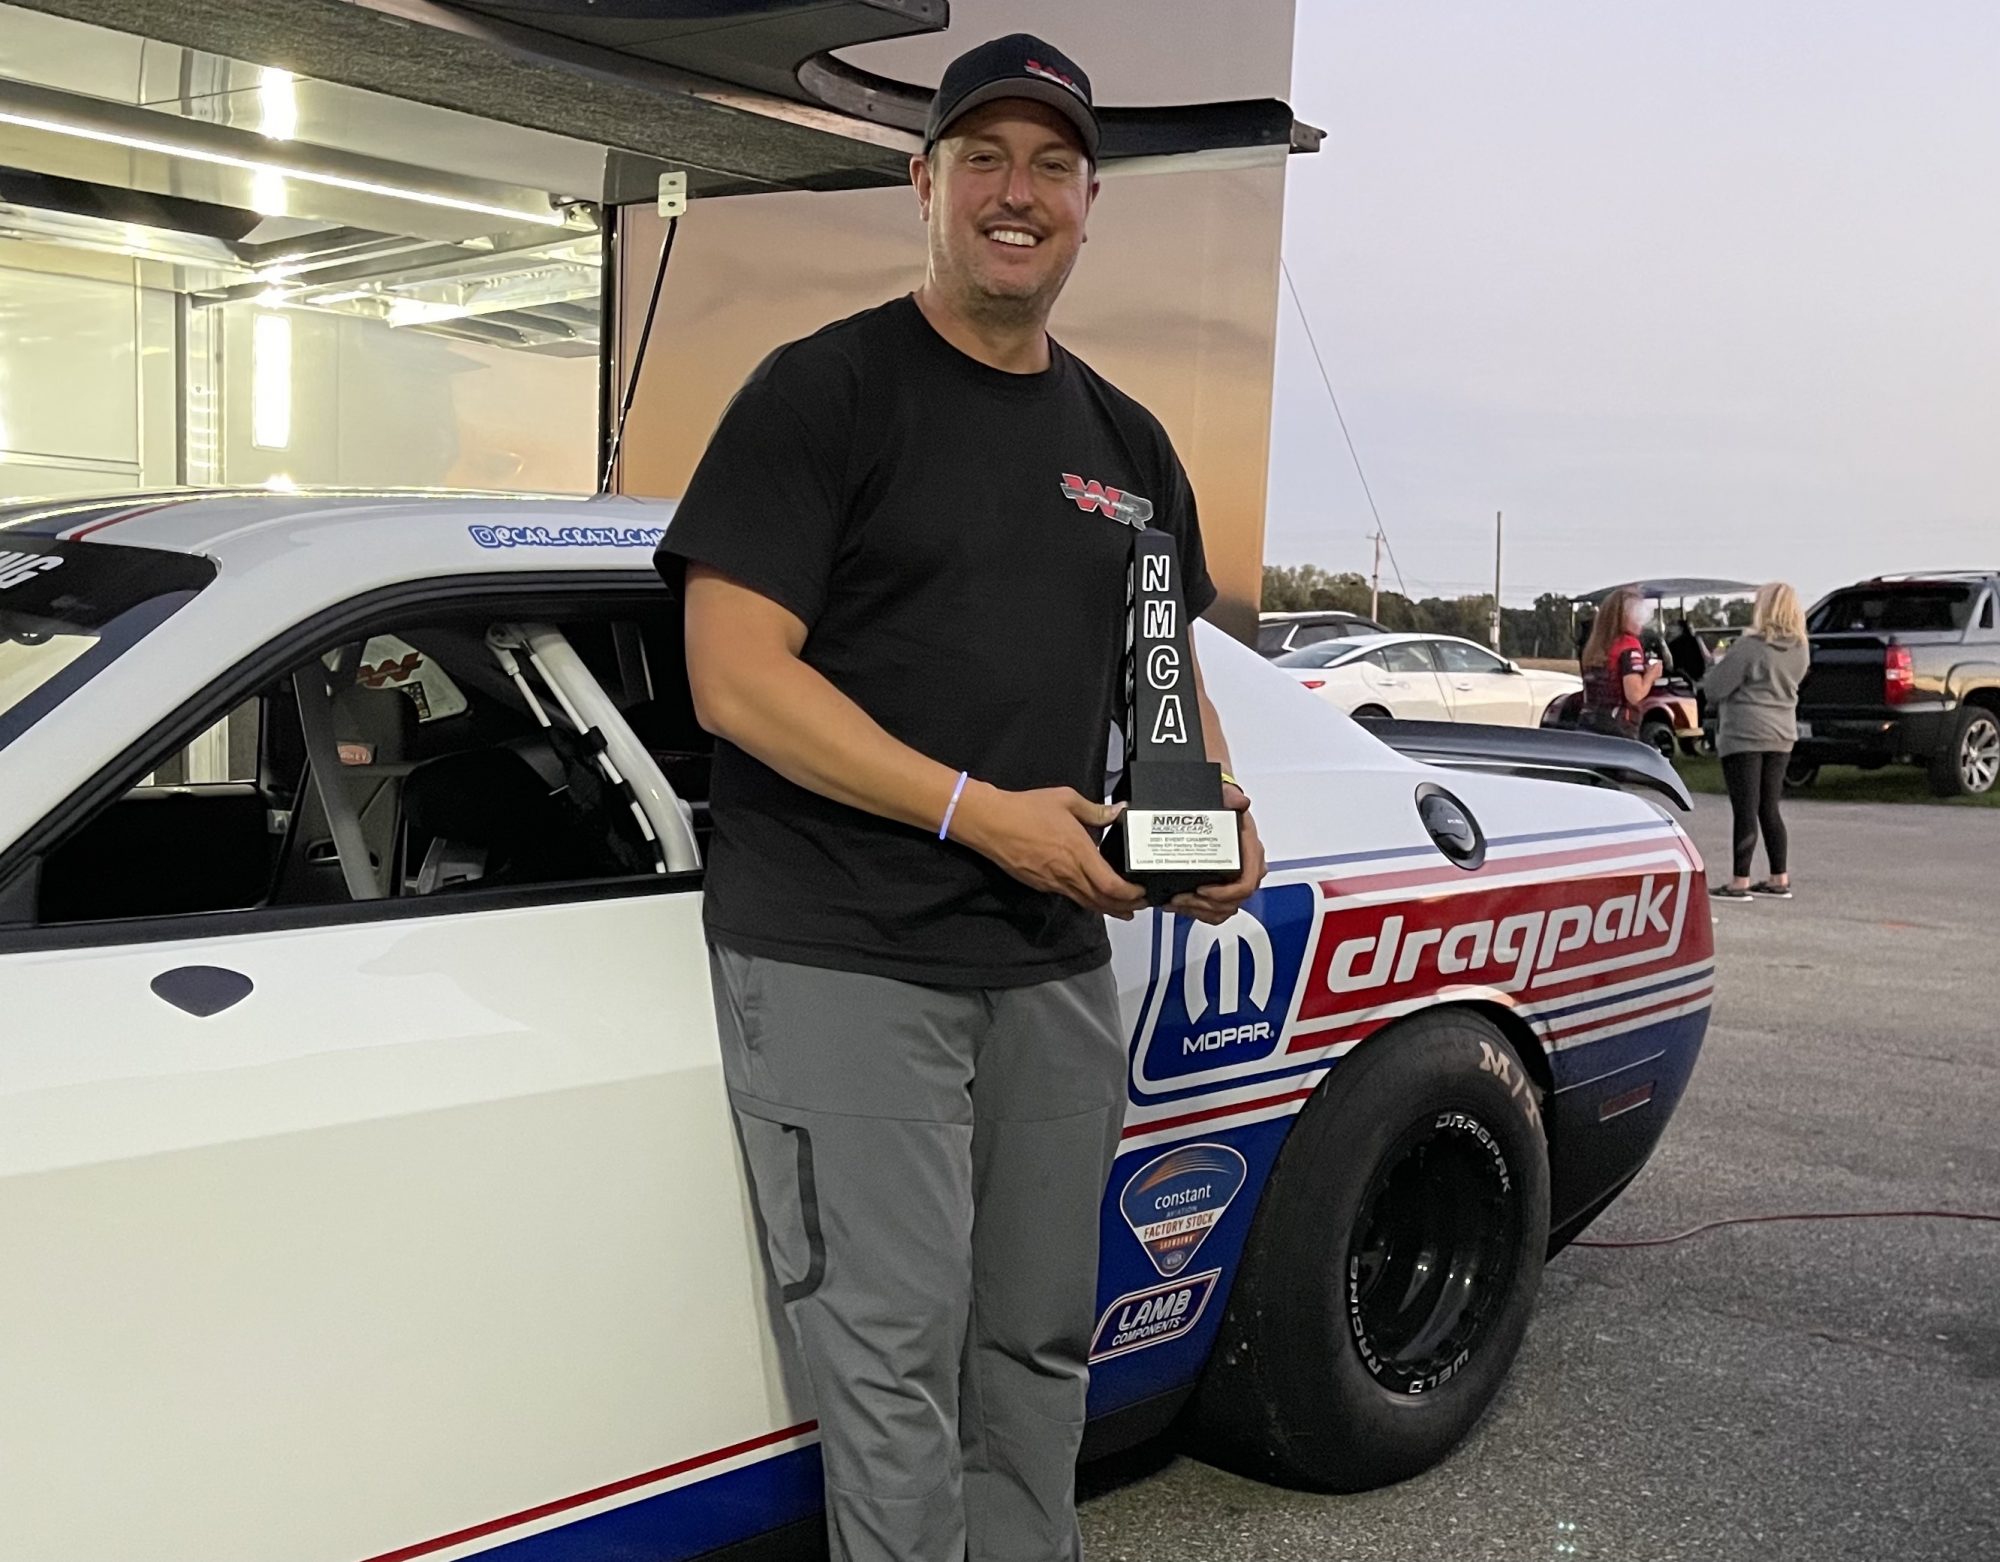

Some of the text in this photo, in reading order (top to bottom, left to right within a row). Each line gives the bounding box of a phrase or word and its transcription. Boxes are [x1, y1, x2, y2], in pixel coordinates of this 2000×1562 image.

[1142, 555, 1188, 743] NMCA
[1152, 815, 1204, 826] NMCA
[1327, 875, 1674, 991] dragpak
[1183, 1021, 1271, 1055] MOPAR
[1436, 1114, 1511, 1192] DRAGPAK
[1155, 1183, 1211, 1210] constant
[1144, 1212, 1215, 1240] FACTORY STOCK
[1118, 1289, 1192, 1331] LAMB
[1350, 1255, 1471, 1394] WELD RACING
[1112, 1316, 1182, 1347] COMPONENTS
